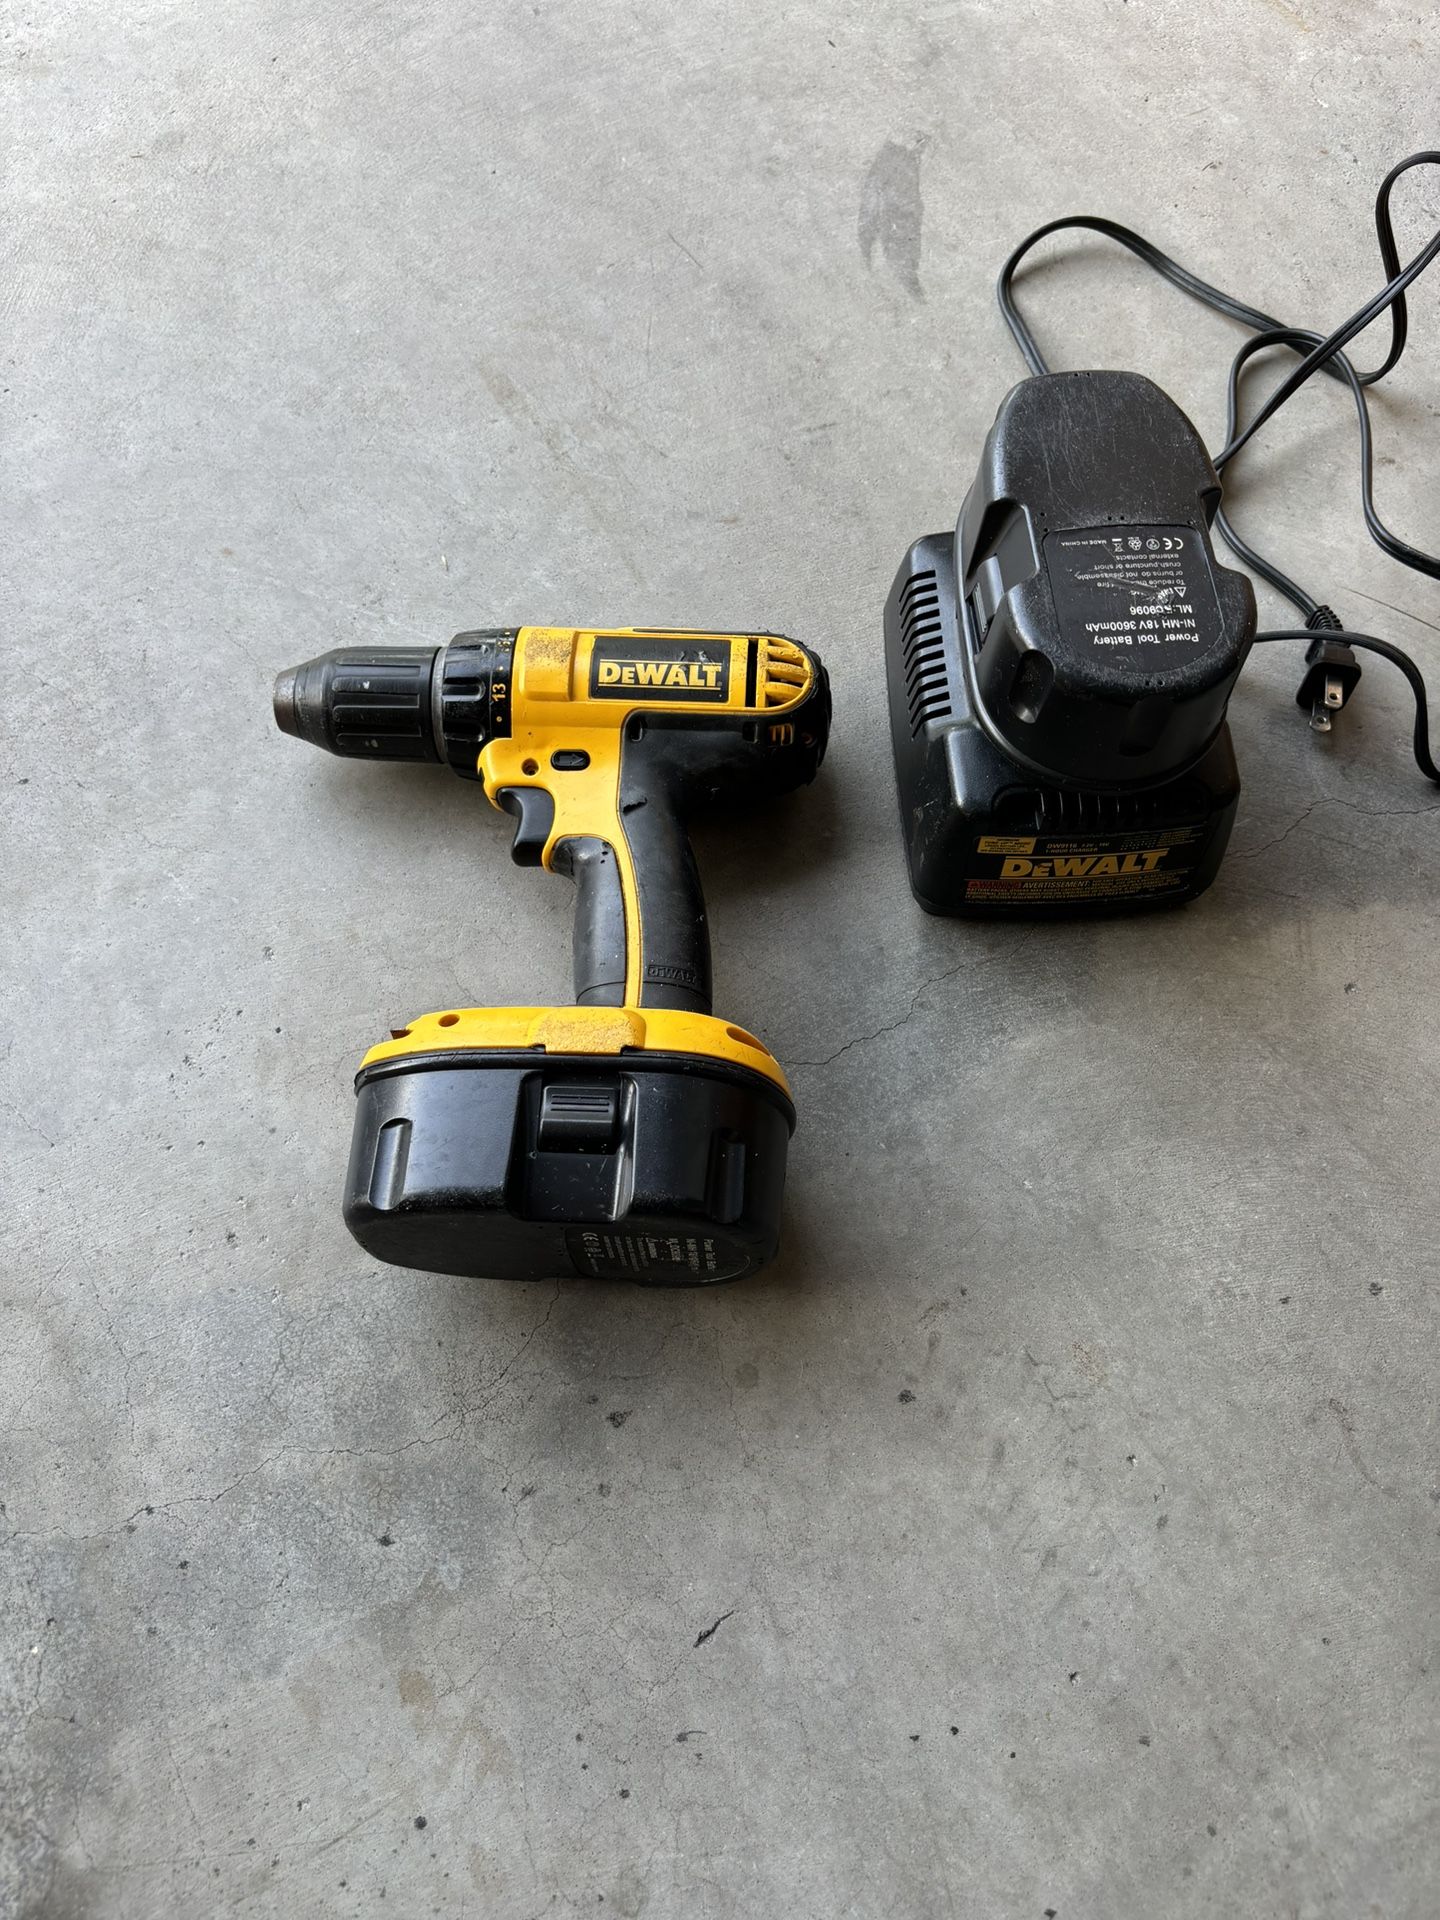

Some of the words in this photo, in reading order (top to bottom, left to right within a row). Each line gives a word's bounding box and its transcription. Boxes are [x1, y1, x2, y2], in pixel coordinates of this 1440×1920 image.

[1085, 621, 1136, 631] 3600mAh
[1140, 620, 1160, 629] 18V
[1094, 635, 1132, 645] Battery
[1137, 635, 1160, 644] Tool
[1165, 633, 1199, 642] Power
[493, 684, 506, 701] 13
[1000, 851, 1166, 877] DEWALT
